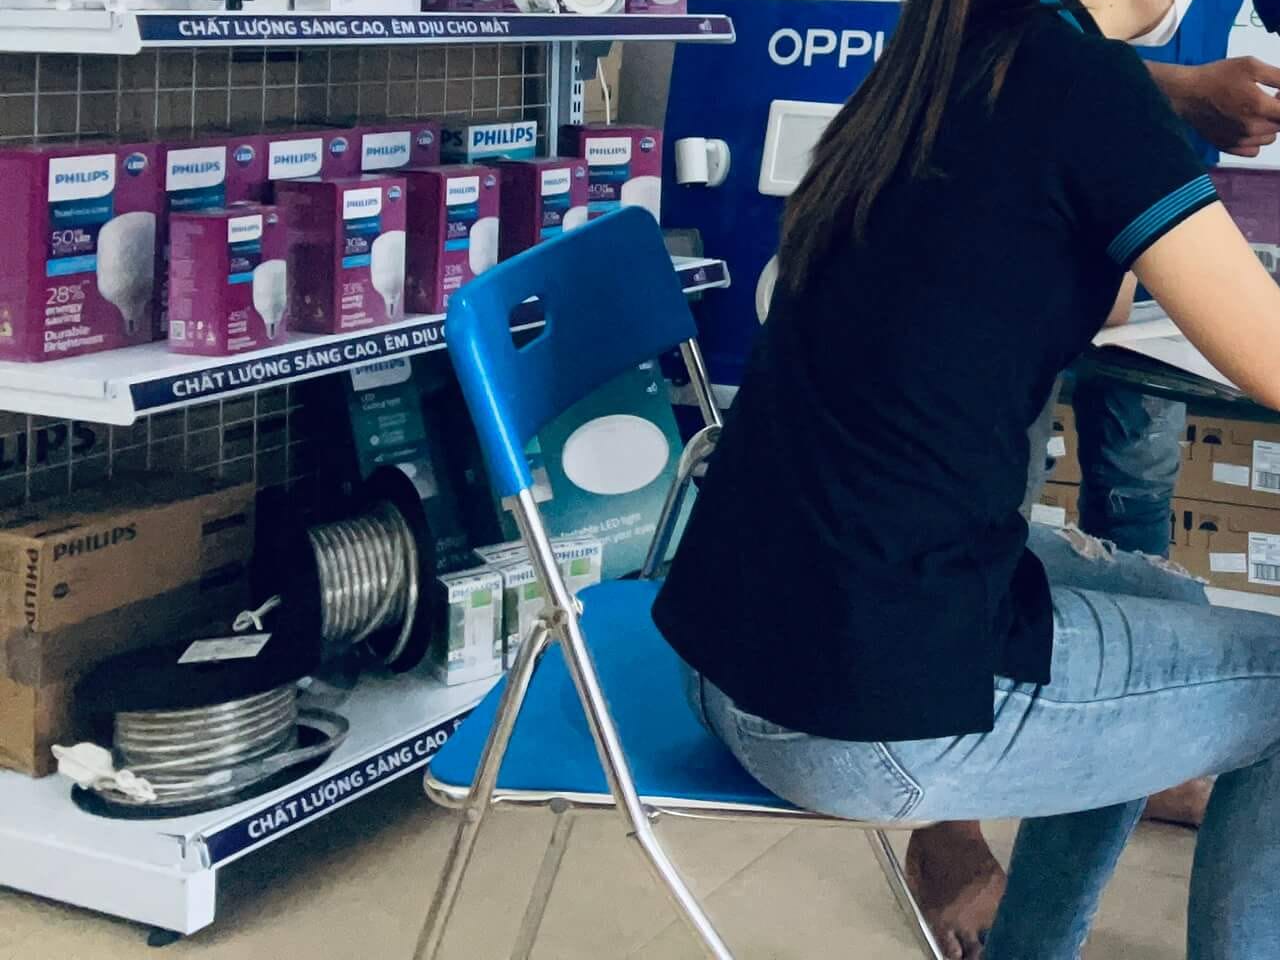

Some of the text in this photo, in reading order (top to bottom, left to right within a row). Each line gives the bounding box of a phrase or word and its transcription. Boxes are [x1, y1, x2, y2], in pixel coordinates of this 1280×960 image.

[178, 18, 230, 37] CHẤT
[234, 17, 298, 40] LƯỢNG
[300, 17, 348, 36] SÁNG
[350, 20, 389, 38] CAO,
[391, 19, 416, 34] ÊM
[418, 20, 445, 38] DỊU
[447, 20, 478, 34] CHO
[473, 126, 534, 147] PHILIPS
[366, 143, 407, 157] PHILIPS
[589, 146, 627, 156] PHILIPS
[273, 152, 318, 166] PHILIPS
[172, 160, 221, 176] PHILIPS
[54, 169, 110, 186] PHILIPS
[448, 185, 476, 195] PHILIPS
[346, 197, 378, 209] PHILIPS
[172, 327, 438, 397] CHẤT LƯỢNG SÁNG CAO, ÊM DỊU
[53, 522, 137, 561] PHILIPS
[554, 546, 600, 561] PHILIPS
[247, 797, 298, 838] CHẤT
[300, 777, 365, 815] LƯỢNG
[366, 745, 413, 781] SÁNG
